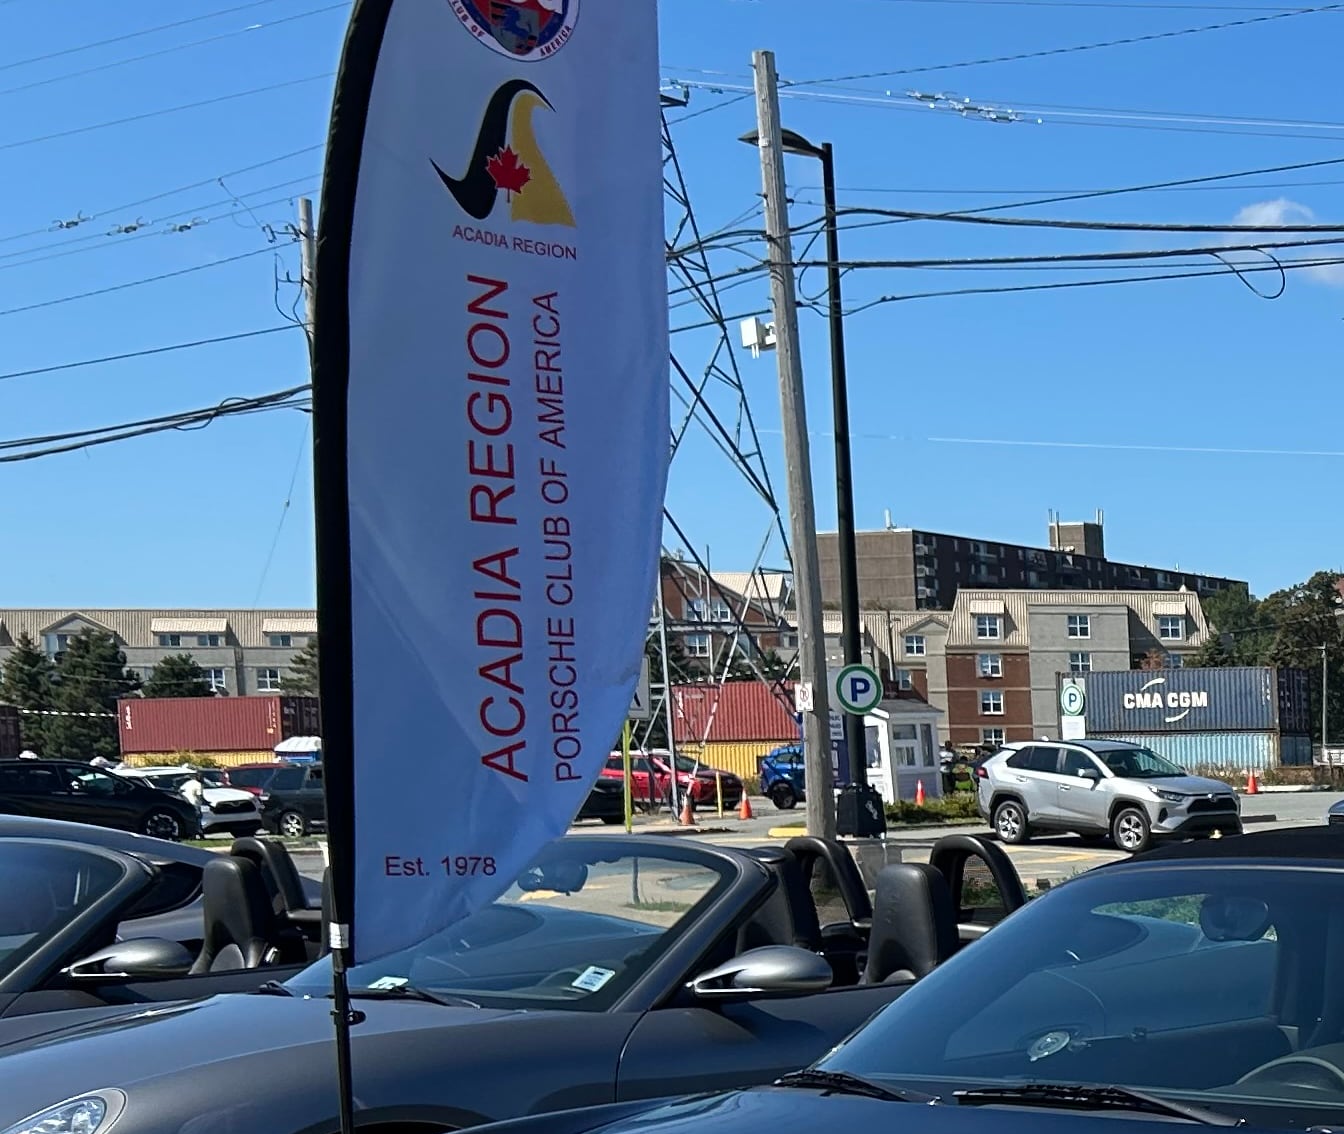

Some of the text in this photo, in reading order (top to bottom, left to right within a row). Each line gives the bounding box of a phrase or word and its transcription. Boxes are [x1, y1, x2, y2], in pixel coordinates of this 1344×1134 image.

[452, 0, 469, 22] LUB
[539, 25, 572, 57] AMERICA
[452, 225, 577, 261] ACADIA REGION
[467, 274, 529, 783] ACADIA REGION
[532, 291, 583, 783] PORSCHE CLUB OF AMERICA
[850, 677, 870, 703] P
[1123, 691, 1208, 709] CMA CGM
[385, 856, 497, 877] Est. 1978
